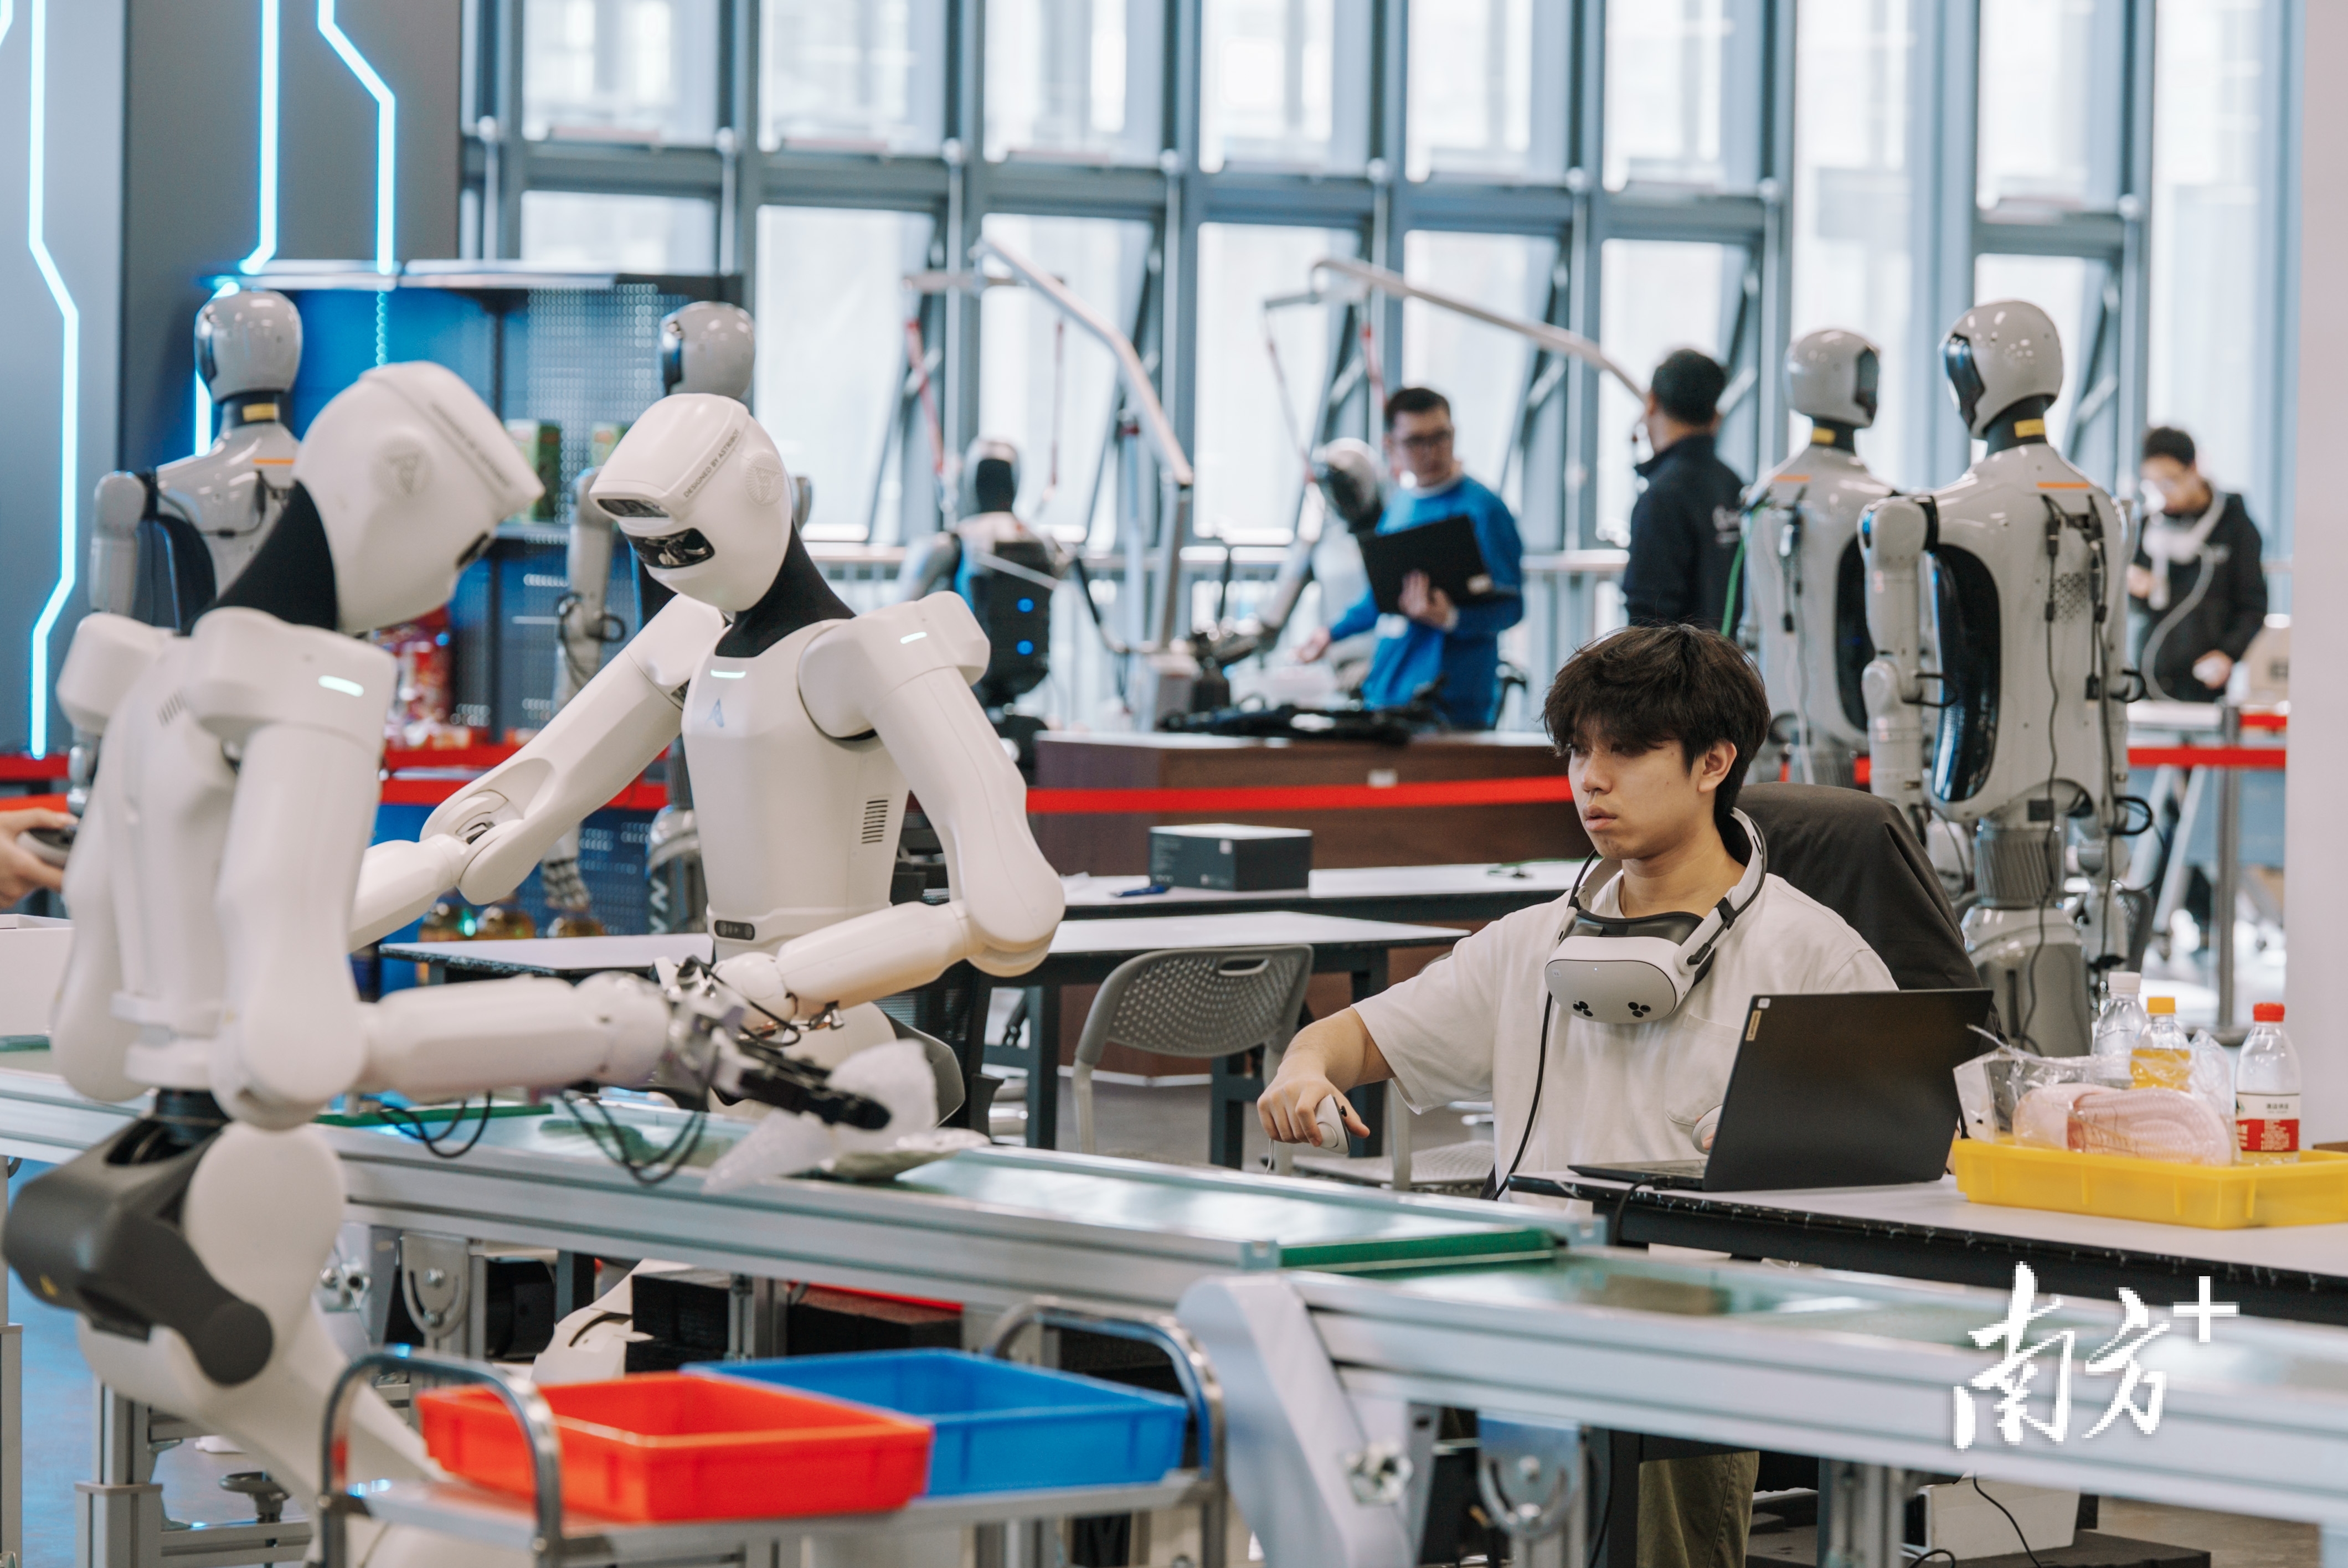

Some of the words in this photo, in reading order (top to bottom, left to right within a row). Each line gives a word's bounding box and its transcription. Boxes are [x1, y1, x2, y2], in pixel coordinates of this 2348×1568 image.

[683, 466, 712, 498] DESIGNED
[710, 457, 719, 467] BY
[718, 428, 740, 459] ASTRIBOT
